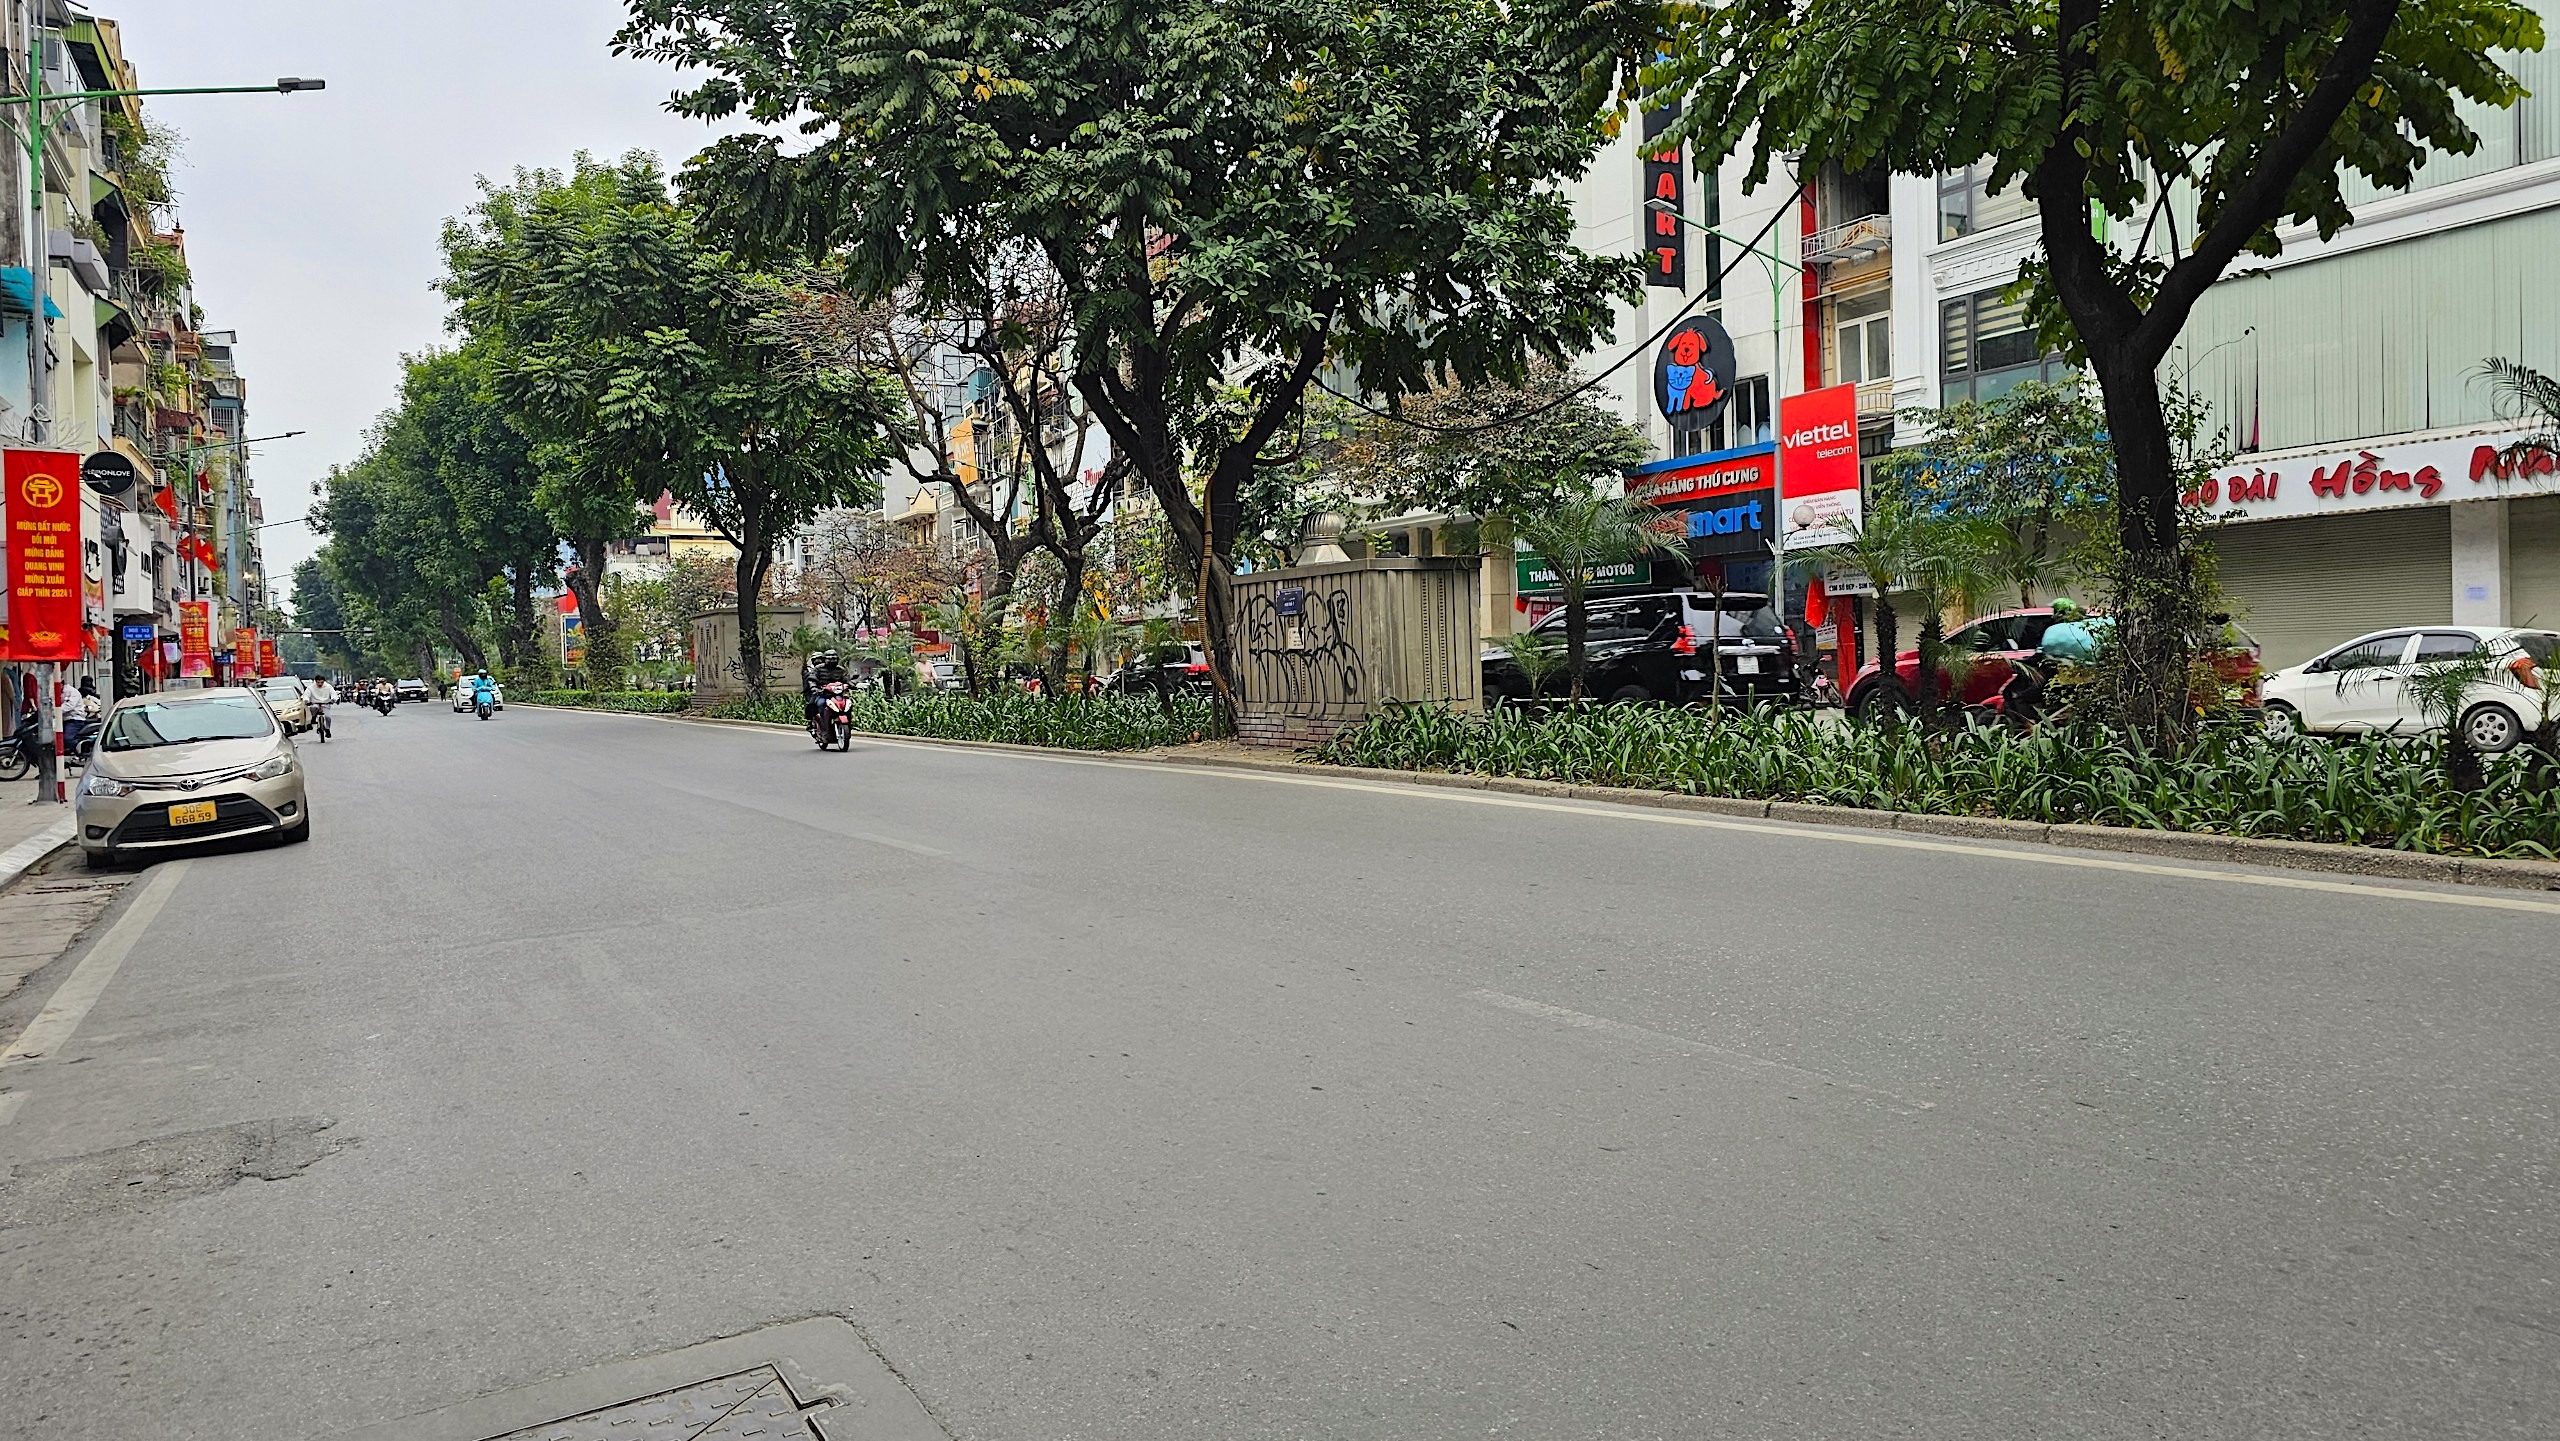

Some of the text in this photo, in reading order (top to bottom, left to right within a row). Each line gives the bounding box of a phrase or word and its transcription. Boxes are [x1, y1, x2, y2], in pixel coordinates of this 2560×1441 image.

[1783, 420, 1852, 449] viettel
[1817, 446, 1853, 459] telecom
[1697, 470, 1721, 489] THÚ
[1722, 466, 1759, 486] CƯNG
[2228, 468, 2279, 502] DÀI
[17, 520, 37, 531] MỪNG
[52, 521, 71, 532] NƯỚC
[43, 533, 57, 545] MỚI
[25, 546, 44, 558] MỪNG
[25, 561, 65, 571] QUANG VINH
[25, 573, 65, 585] MỪNG XUÂN
[1529, 566, 1560, 583] THÀN
[17, 586, 33, 597] GIÁP
[182, 804, 202, 815] 30E
[175, 812, 212, 825] 668.59
